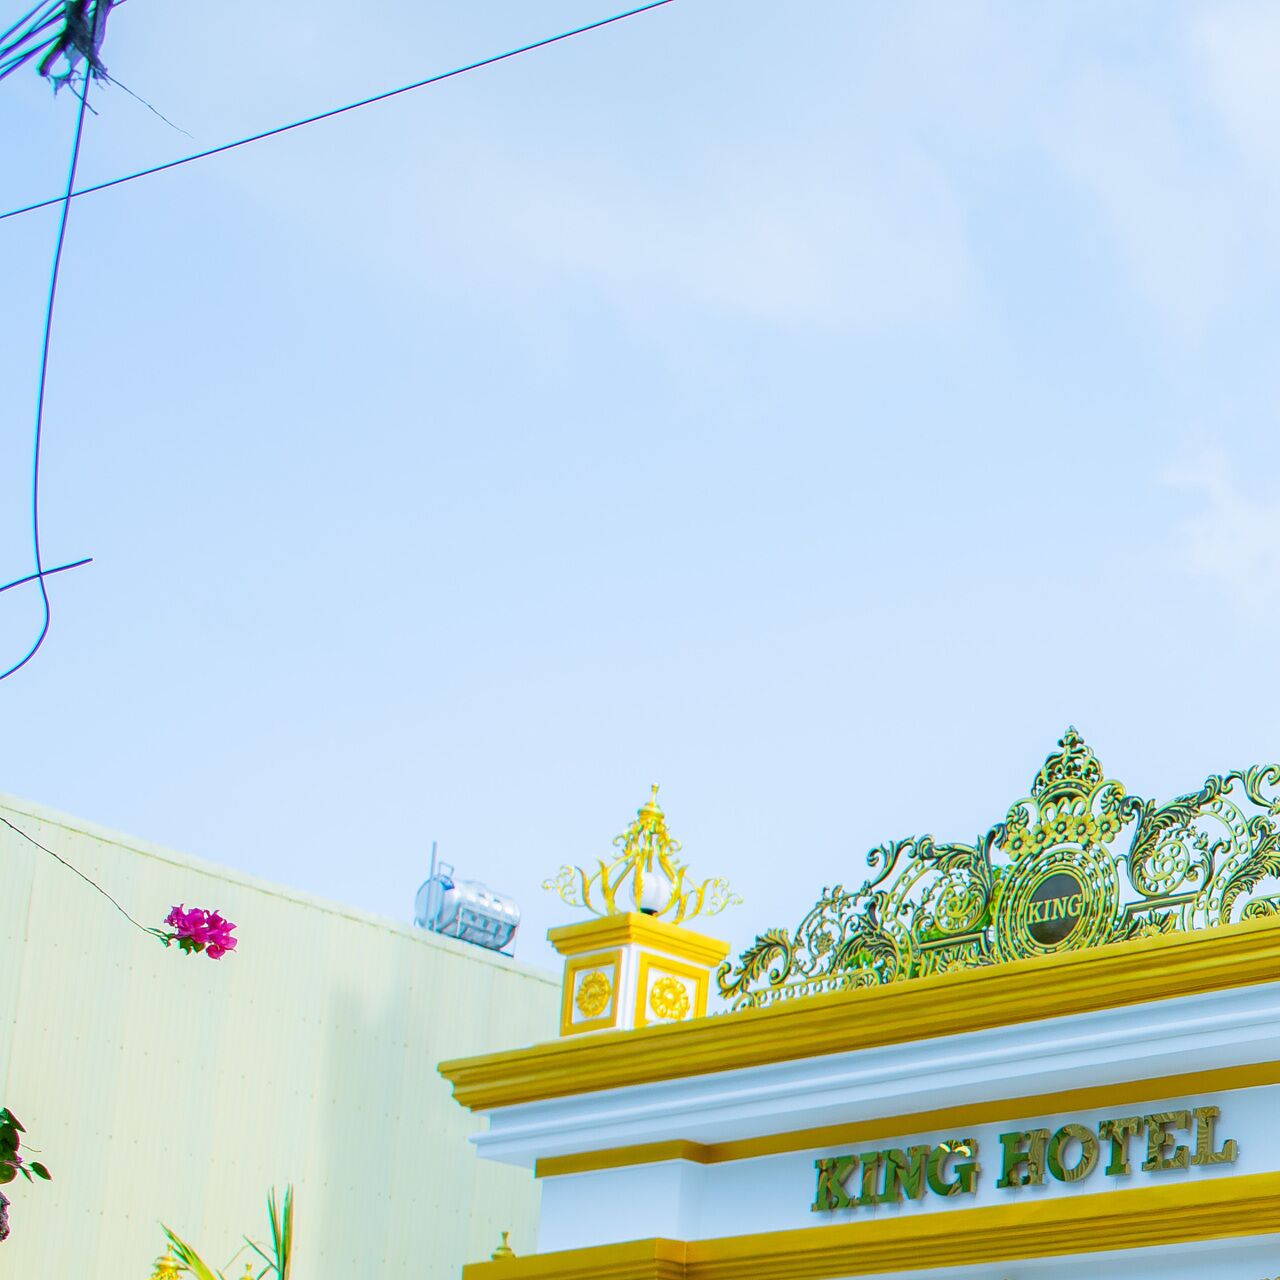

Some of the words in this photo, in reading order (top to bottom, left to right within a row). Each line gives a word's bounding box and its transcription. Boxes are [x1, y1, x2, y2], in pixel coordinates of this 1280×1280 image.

[1028, 893, 1083, 925] KING
[811, 1137, 982, 1213] KING
[996, 1105, 1239, 1190] HOTEL
